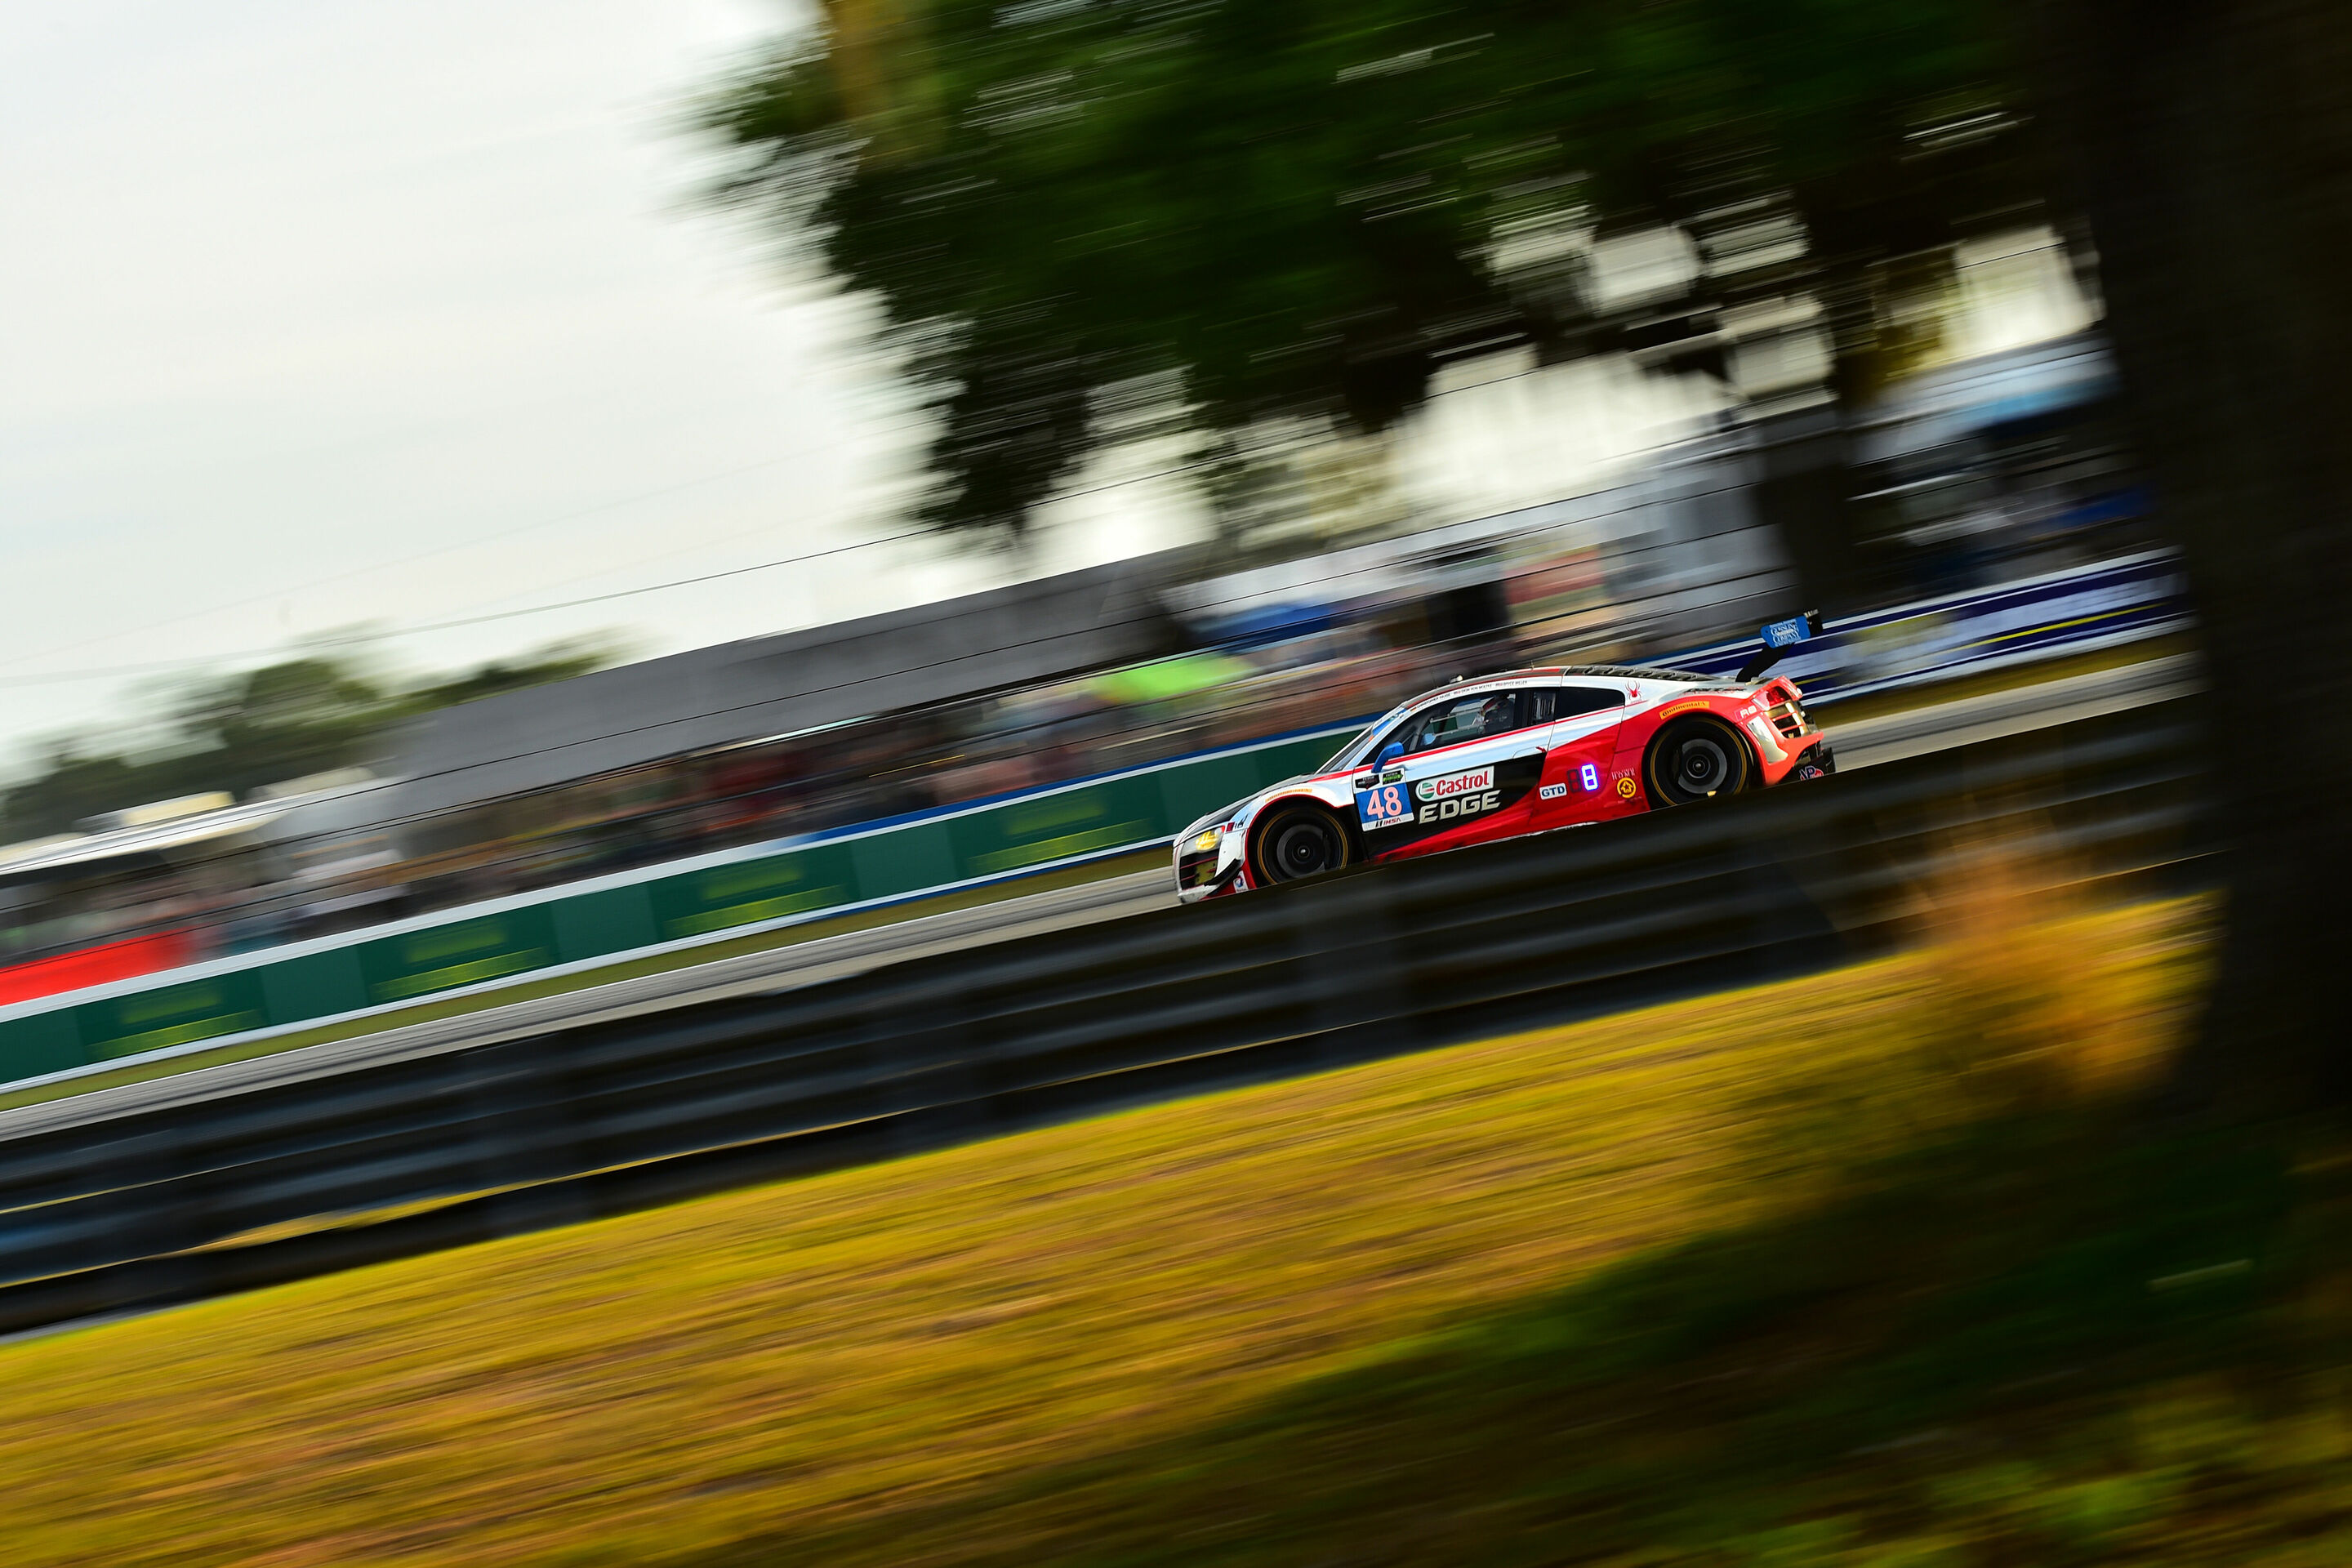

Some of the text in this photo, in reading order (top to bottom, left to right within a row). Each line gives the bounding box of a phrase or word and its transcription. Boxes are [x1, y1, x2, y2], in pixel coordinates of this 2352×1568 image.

[1436, 771, 1490, 796] Castrol
[1581, 764, 1598, 791] 8
[1366, 786, 1402, 819] 48
[1541, 786, 1566, 797] GTD
[1419, 790, 1502, 825] EDGE
[1383, 817, 1401, 826] IMSA
